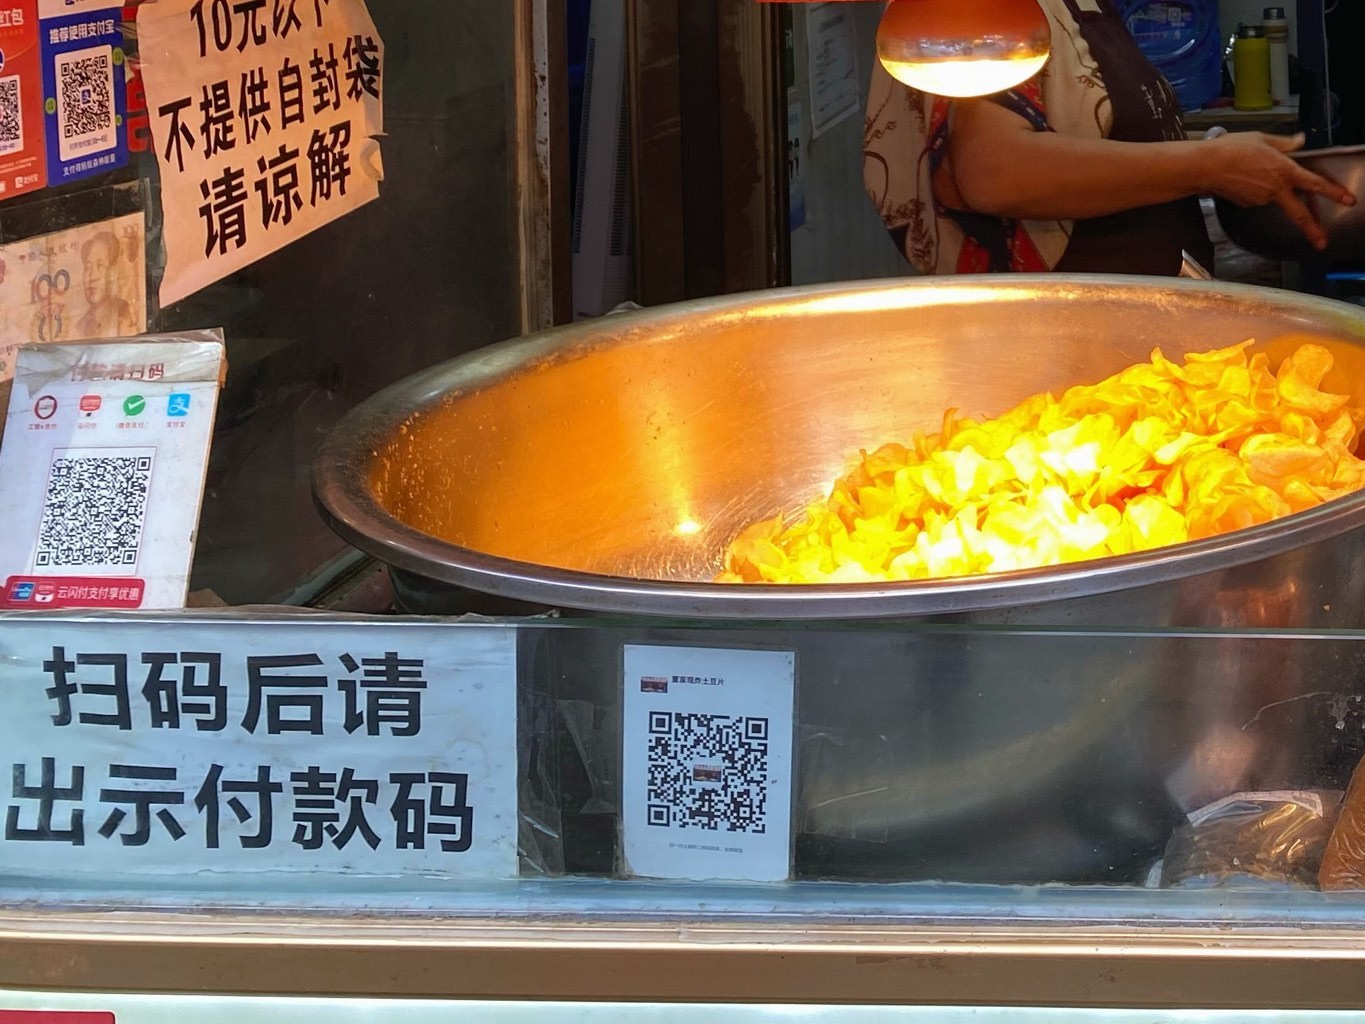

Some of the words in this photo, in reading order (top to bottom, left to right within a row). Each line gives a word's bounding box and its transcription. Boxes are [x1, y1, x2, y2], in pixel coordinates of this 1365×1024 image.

[49, 19, 115, 44] 推荐使用支付宝
[158, 34, 381, 173] 不提供自封袋
[199, 120, 352, 259] 请谅解
[57, 586, 140, 602] 云闪付支付享优惠
[43, 645, 428, 738] 扫码后请
[4, 756, 475, 853] 出示付款码
